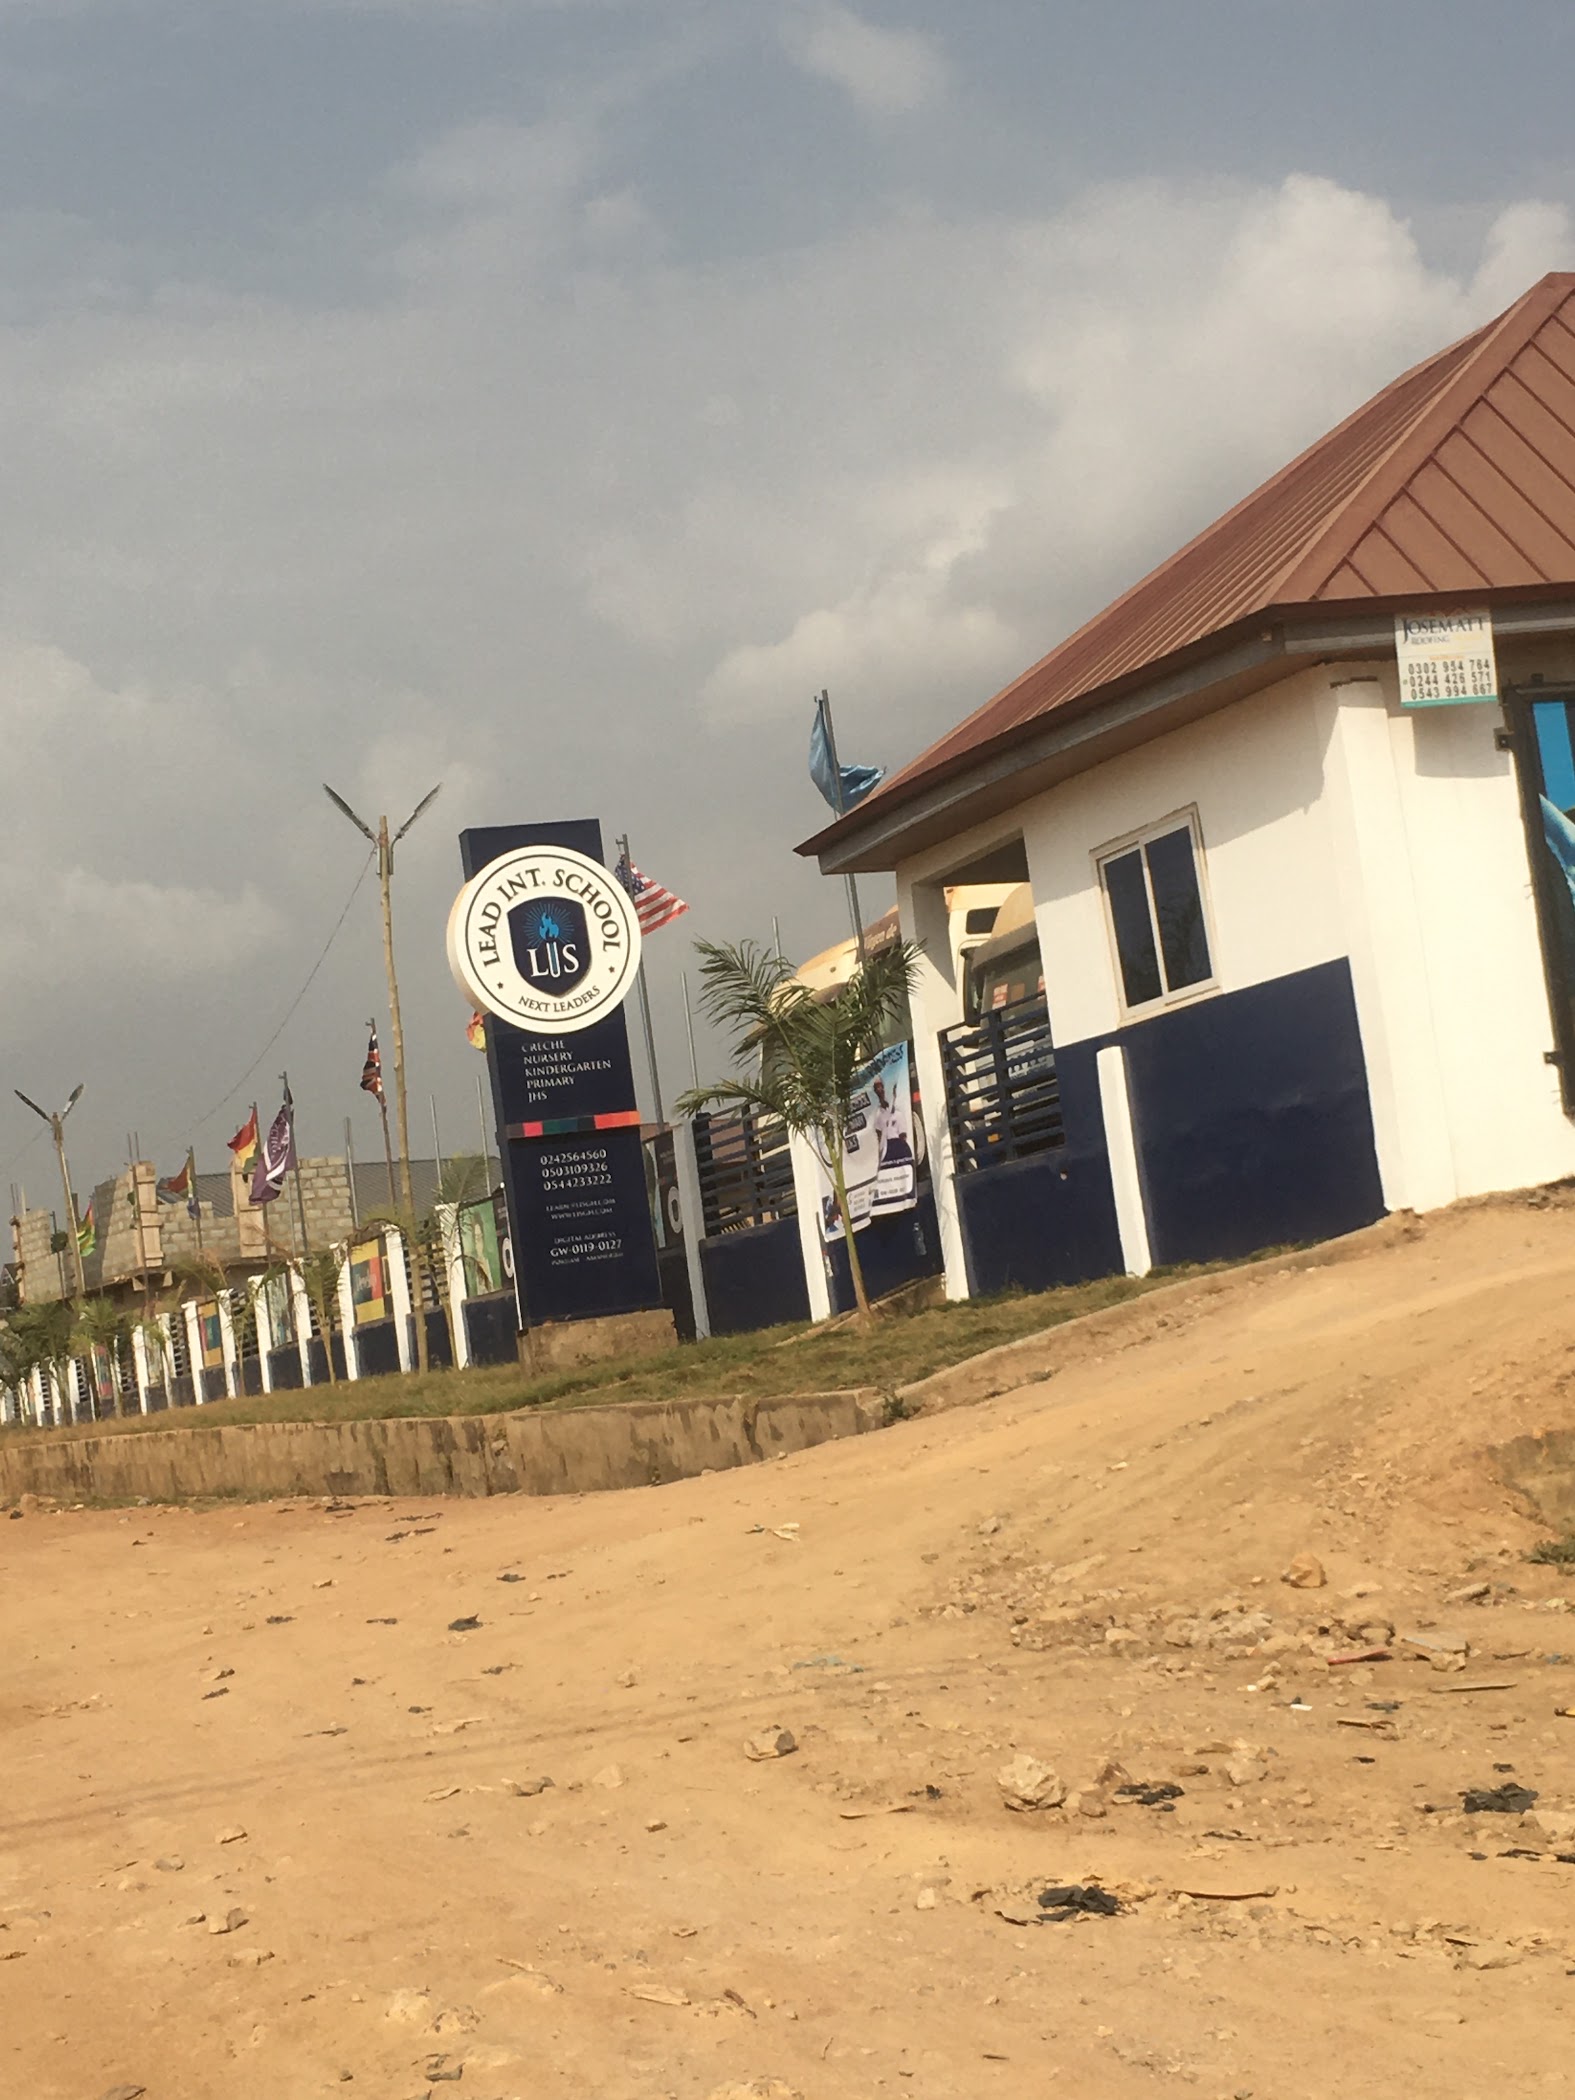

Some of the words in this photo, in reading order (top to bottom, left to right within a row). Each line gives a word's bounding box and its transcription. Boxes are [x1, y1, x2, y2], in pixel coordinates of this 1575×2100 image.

[1402, 616, 1484, 644] JOSEMATT
[1408, 662, 1437, 675] 0302
[1442, 660, 1465, 673] 954
[1409, 674, 1439, 688] 0244
[1444, 672, 1466, 684] 426
[1471, 671, 1491, 683] 571
[1411, 686, 1440, 700] 0543
[1445, 685, 1467, 697] 994
[1472, 682, 1492, 695] 667
[478, 901, 502, 968] LEAD
[497, 867, 546, 902] INT.
[553, 868, 621, 953] SCHOOL
[518, 995, 551, 1013] NEXT
[553, 985, 601, 1013] LEADERS
[521, 1040, 566, 1053] CRECHE
[523, 1051, 573, 1065] NURSERY
[525, 1060, 612, 1077] KINDERGARTEN
[526, 1076, 576, 1089] PRIMARY
[528, 1090, 548, 1103] JHS
[540, 1148, 607, 1166] 0242564560
[541, 1161, 608, 1178] 0503109326
[543, 1174, 612, 1191] 0544233222
